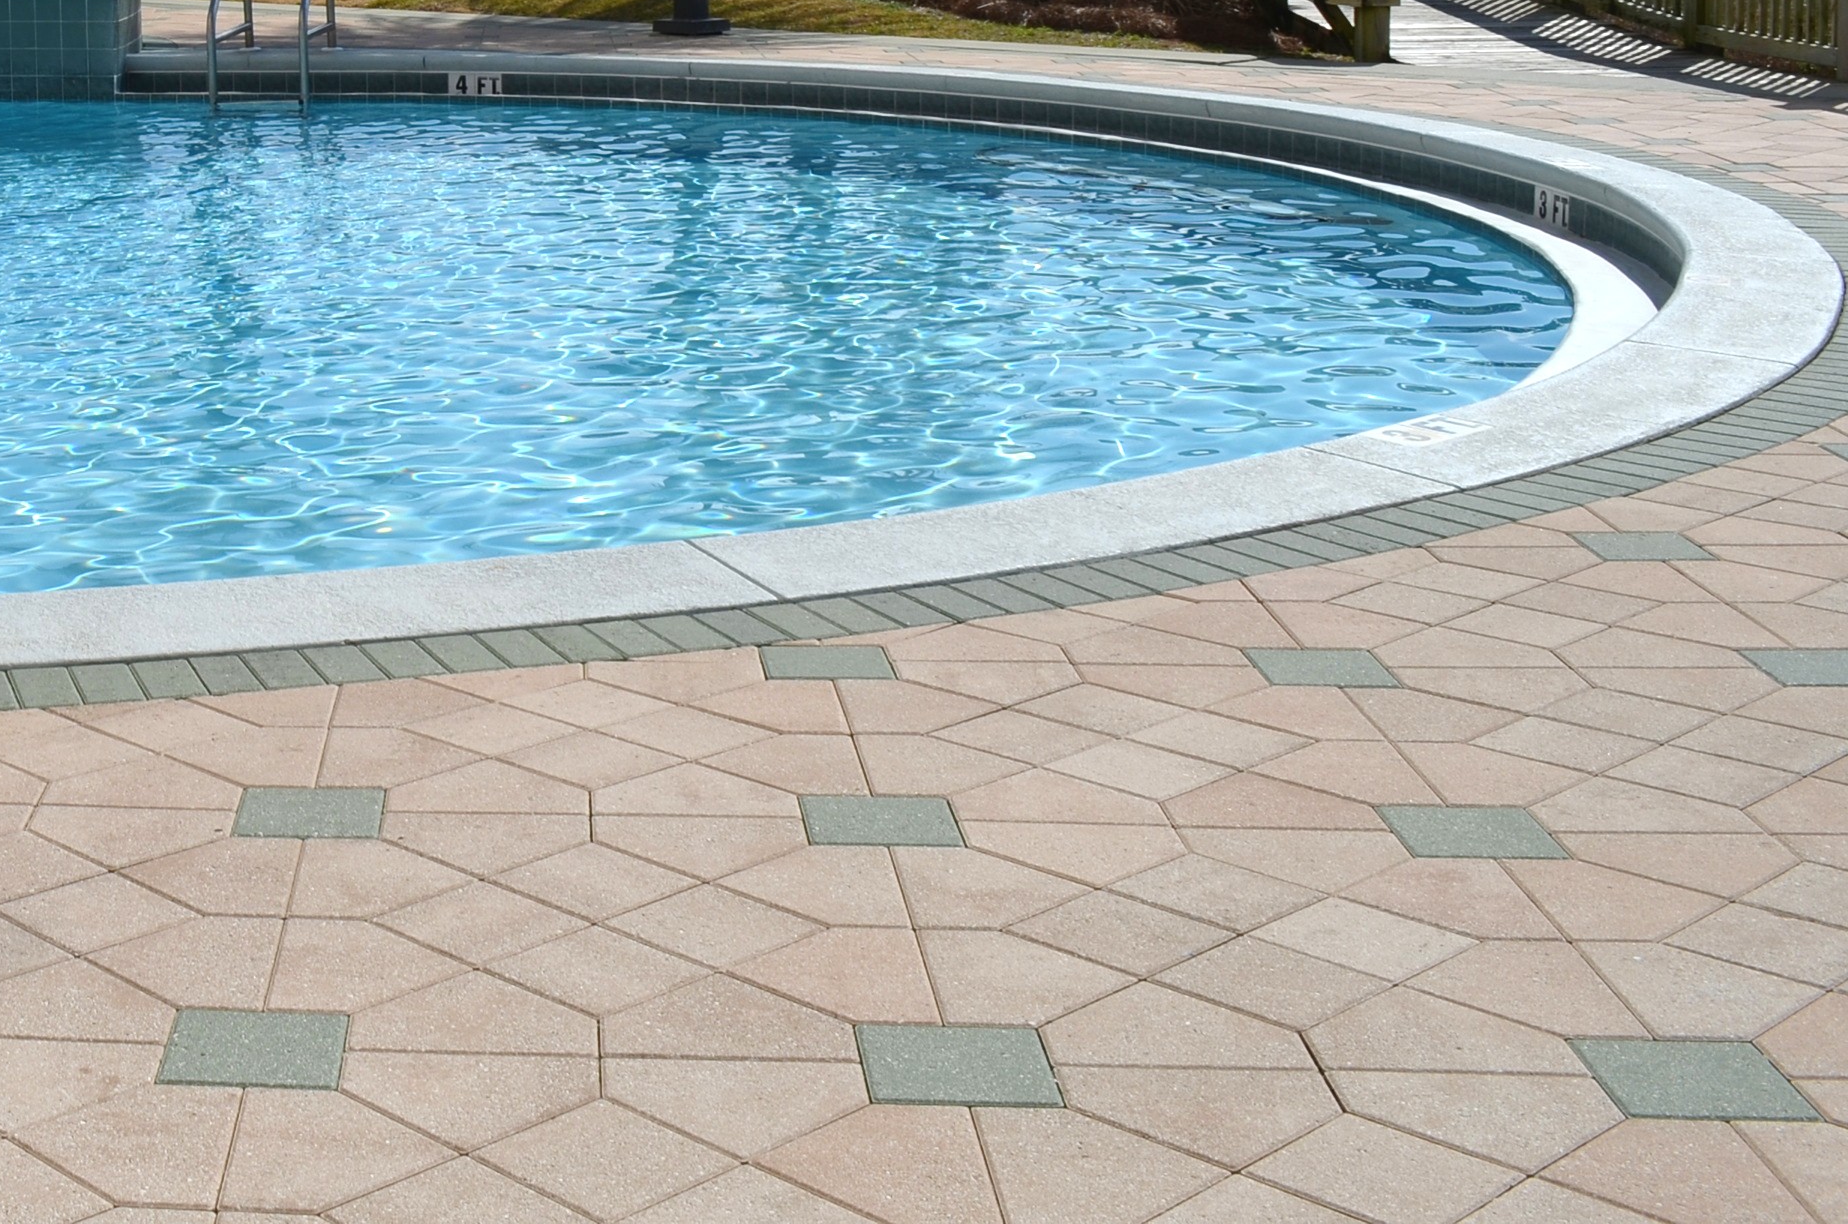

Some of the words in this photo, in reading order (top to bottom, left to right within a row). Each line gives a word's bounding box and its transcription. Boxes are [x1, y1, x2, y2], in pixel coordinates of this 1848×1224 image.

[455, 75, 468, 94] 4
[1539, 190, 1548, 219] 3
[1382, 430, 1432, 442] 3
